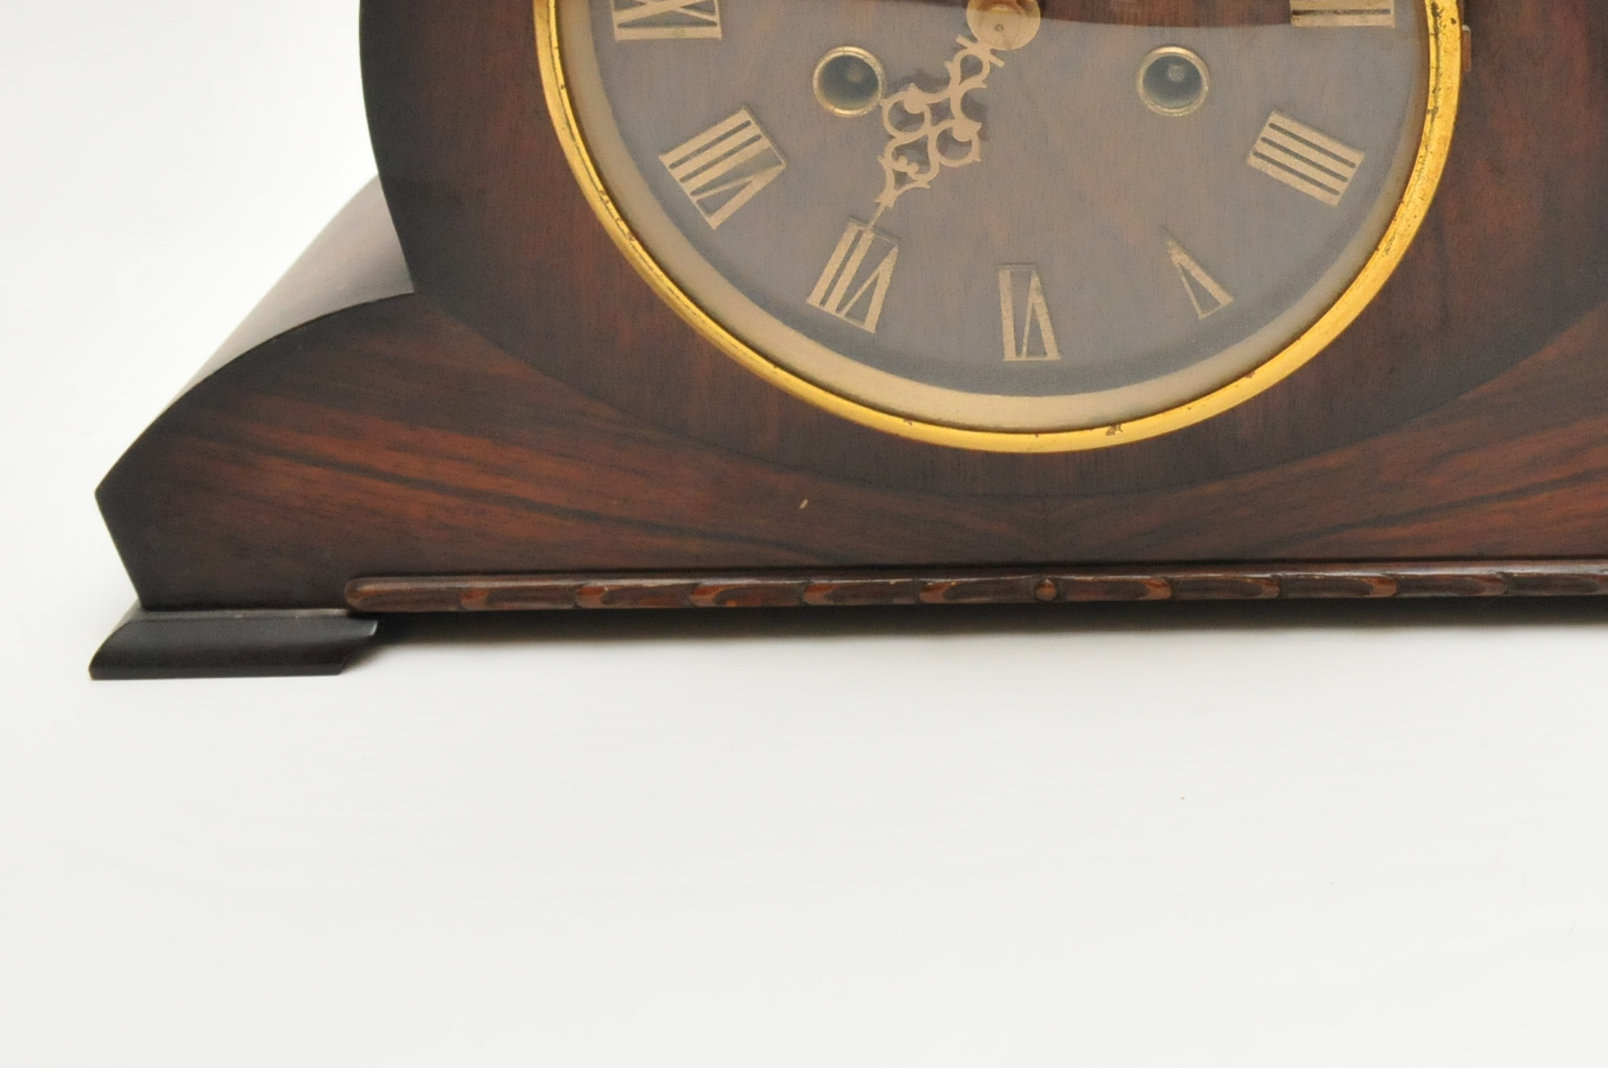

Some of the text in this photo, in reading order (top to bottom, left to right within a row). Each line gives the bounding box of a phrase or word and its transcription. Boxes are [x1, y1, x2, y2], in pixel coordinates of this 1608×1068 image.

[658, 106, 788, 229] VIII
[807, 218, 898, 333] VII
[999, 264, 1062, 362] VI
[1163, 230, 1234, 319] V
